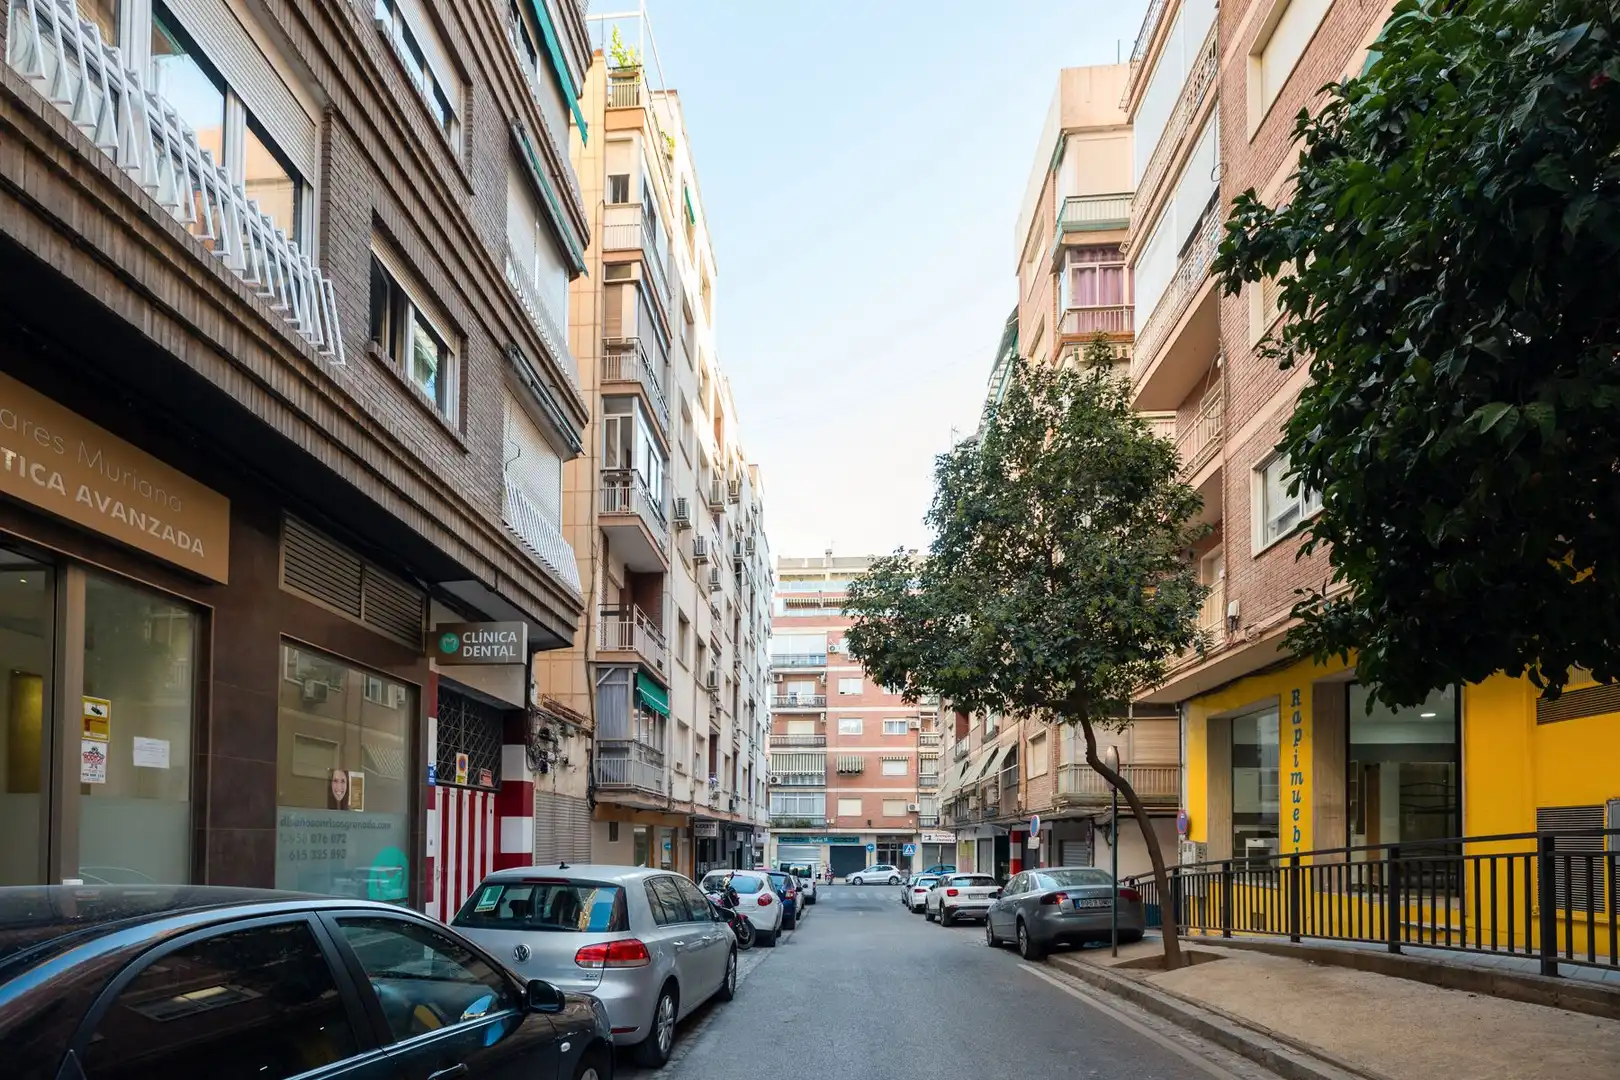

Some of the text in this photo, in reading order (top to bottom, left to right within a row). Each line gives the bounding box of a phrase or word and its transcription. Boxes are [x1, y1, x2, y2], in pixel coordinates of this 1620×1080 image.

[0, 409, 182, 512] ares Muriana
[0, 446, 205, 558] TICA AVANZADA
[462, 629, 517, 643] CLÍNICA
[463, 645, 516, 657] DENTAL
